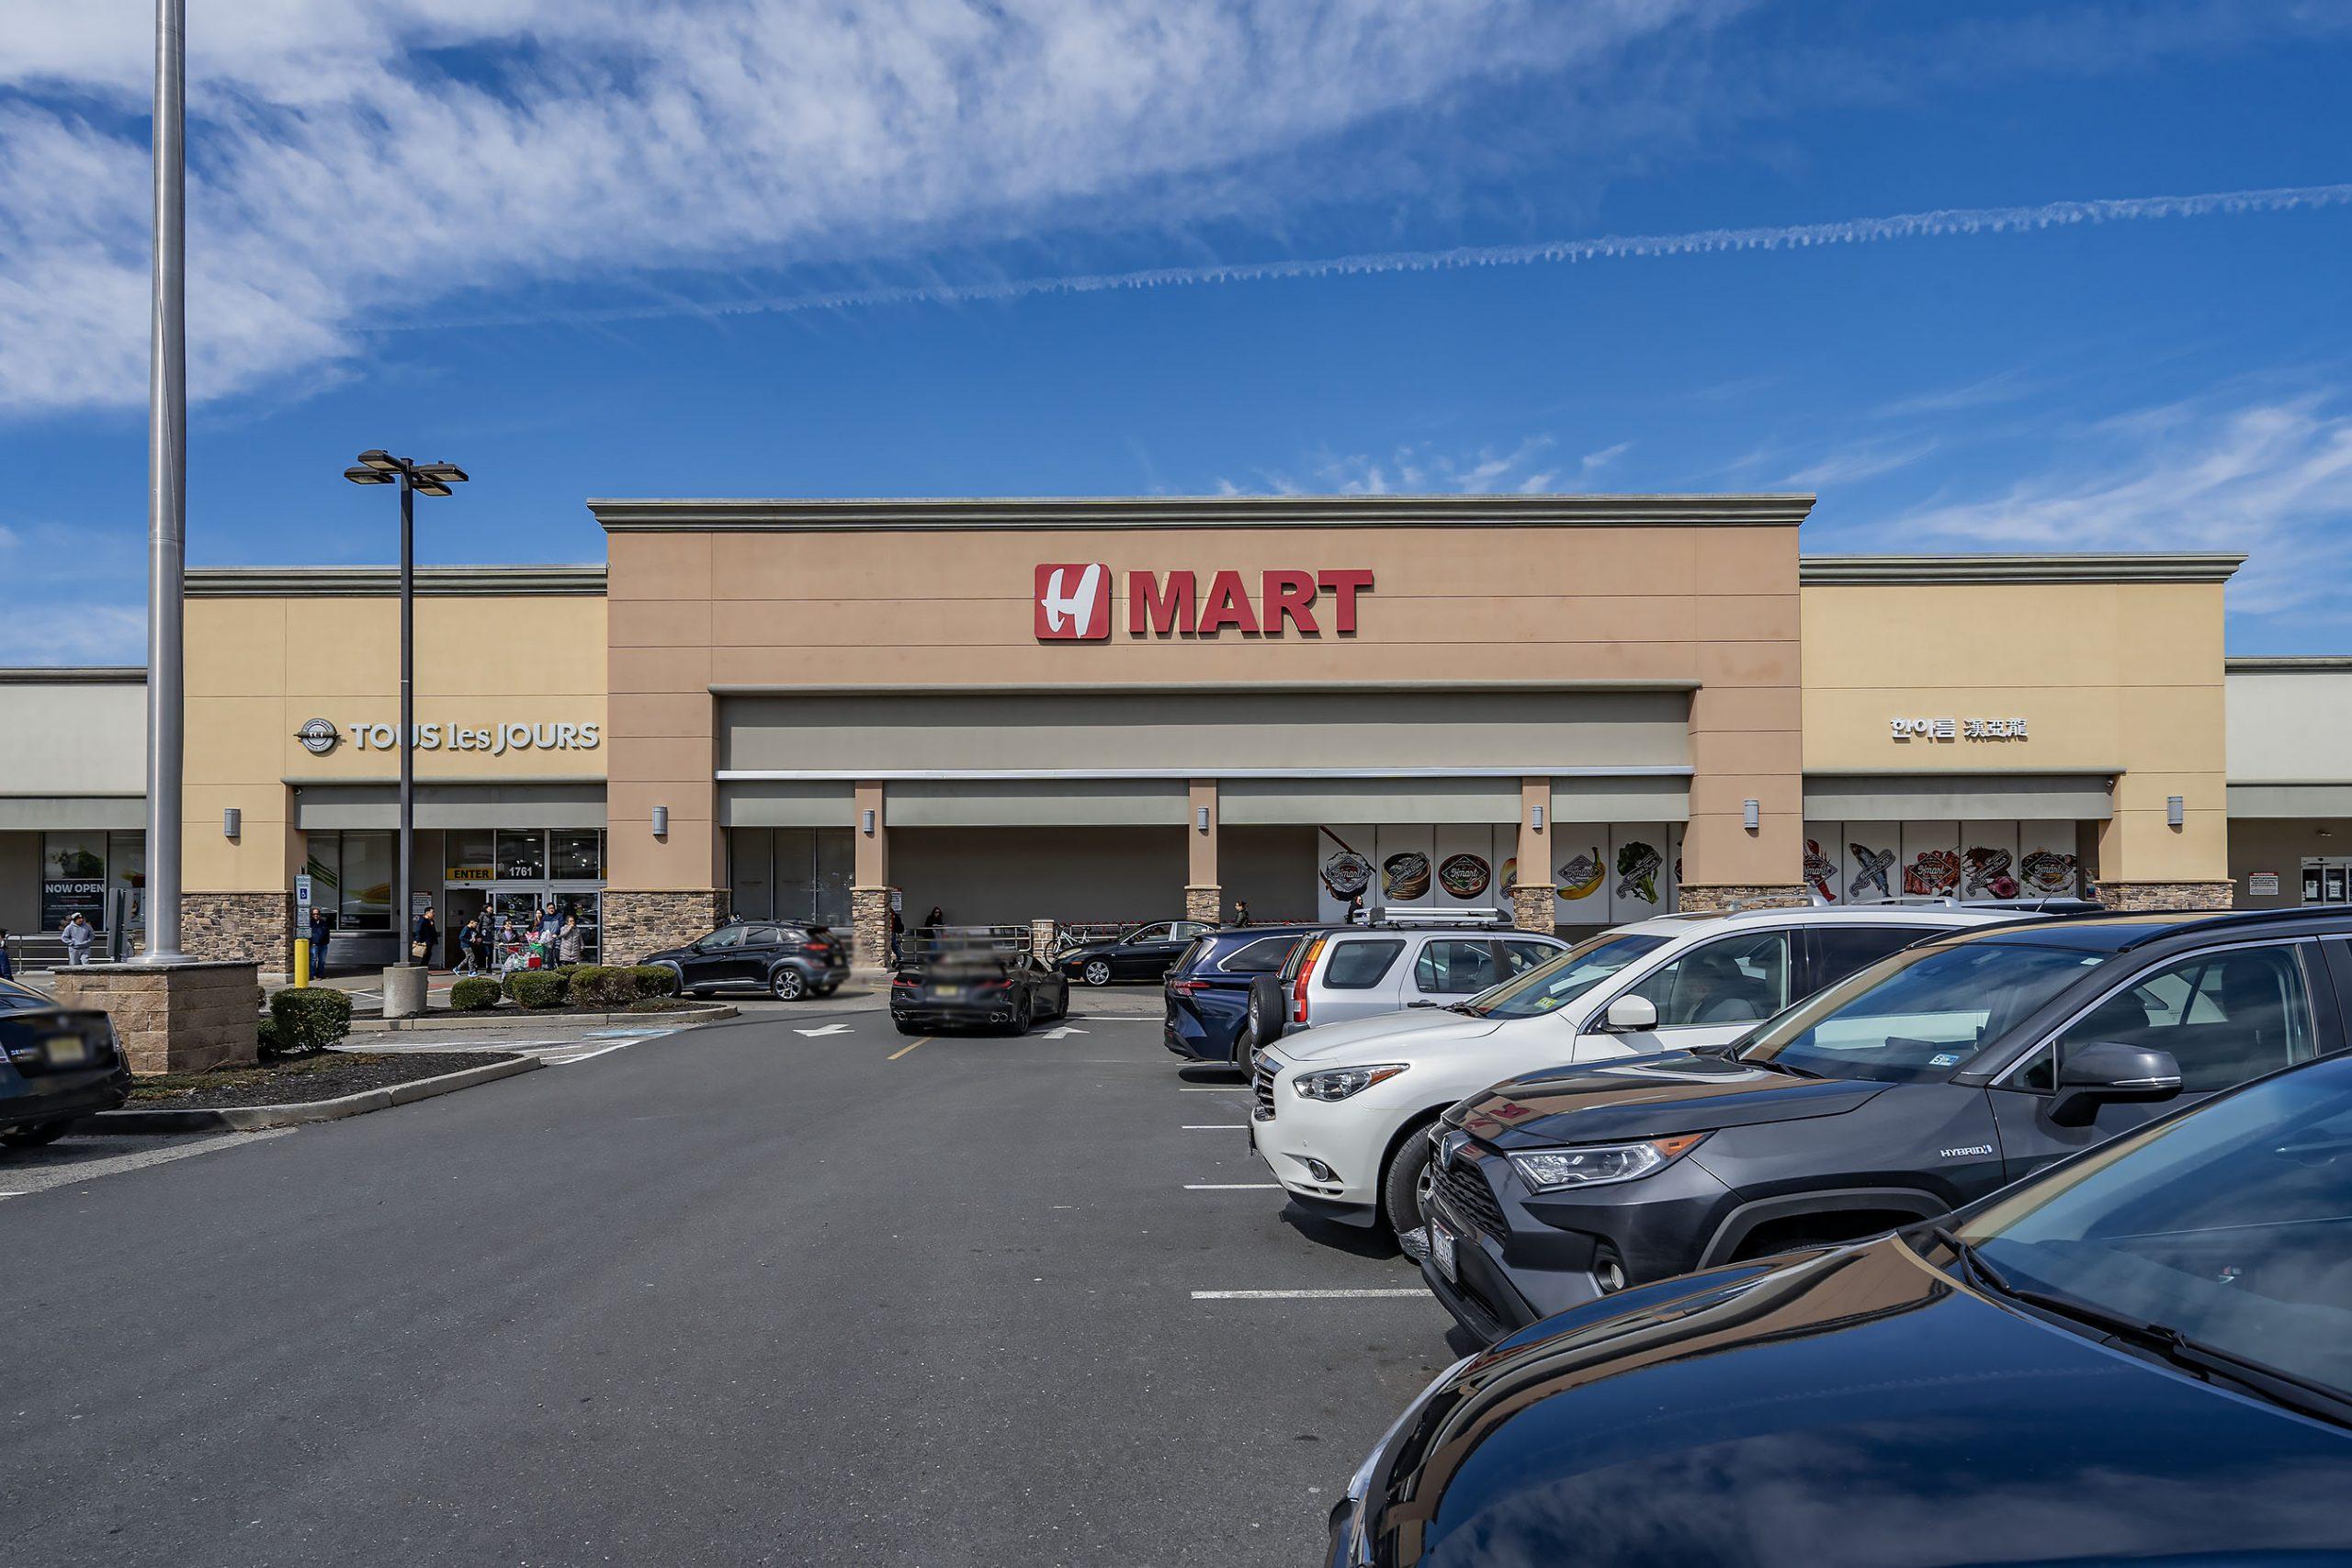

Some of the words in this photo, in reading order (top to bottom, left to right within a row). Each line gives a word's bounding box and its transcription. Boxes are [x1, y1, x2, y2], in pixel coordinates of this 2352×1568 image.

[1040, 563, 1101, 639] H
[1129, 570, 1374, 633] MART
[1891, 719, 1956, 739] 한아름
[350, 724, 442, 749] TOUS
[447, 723, 491, 749] les
[492, 723, 601, 756] JOURS
[454, 869, 489, 879] ENTER
[509, 866, 532, 876] 1761
[45, 884, 73, 894] NOW
[74, 884, 105, 894] OPEN
[1939, 1145, 1986, 1157] HYBRID
